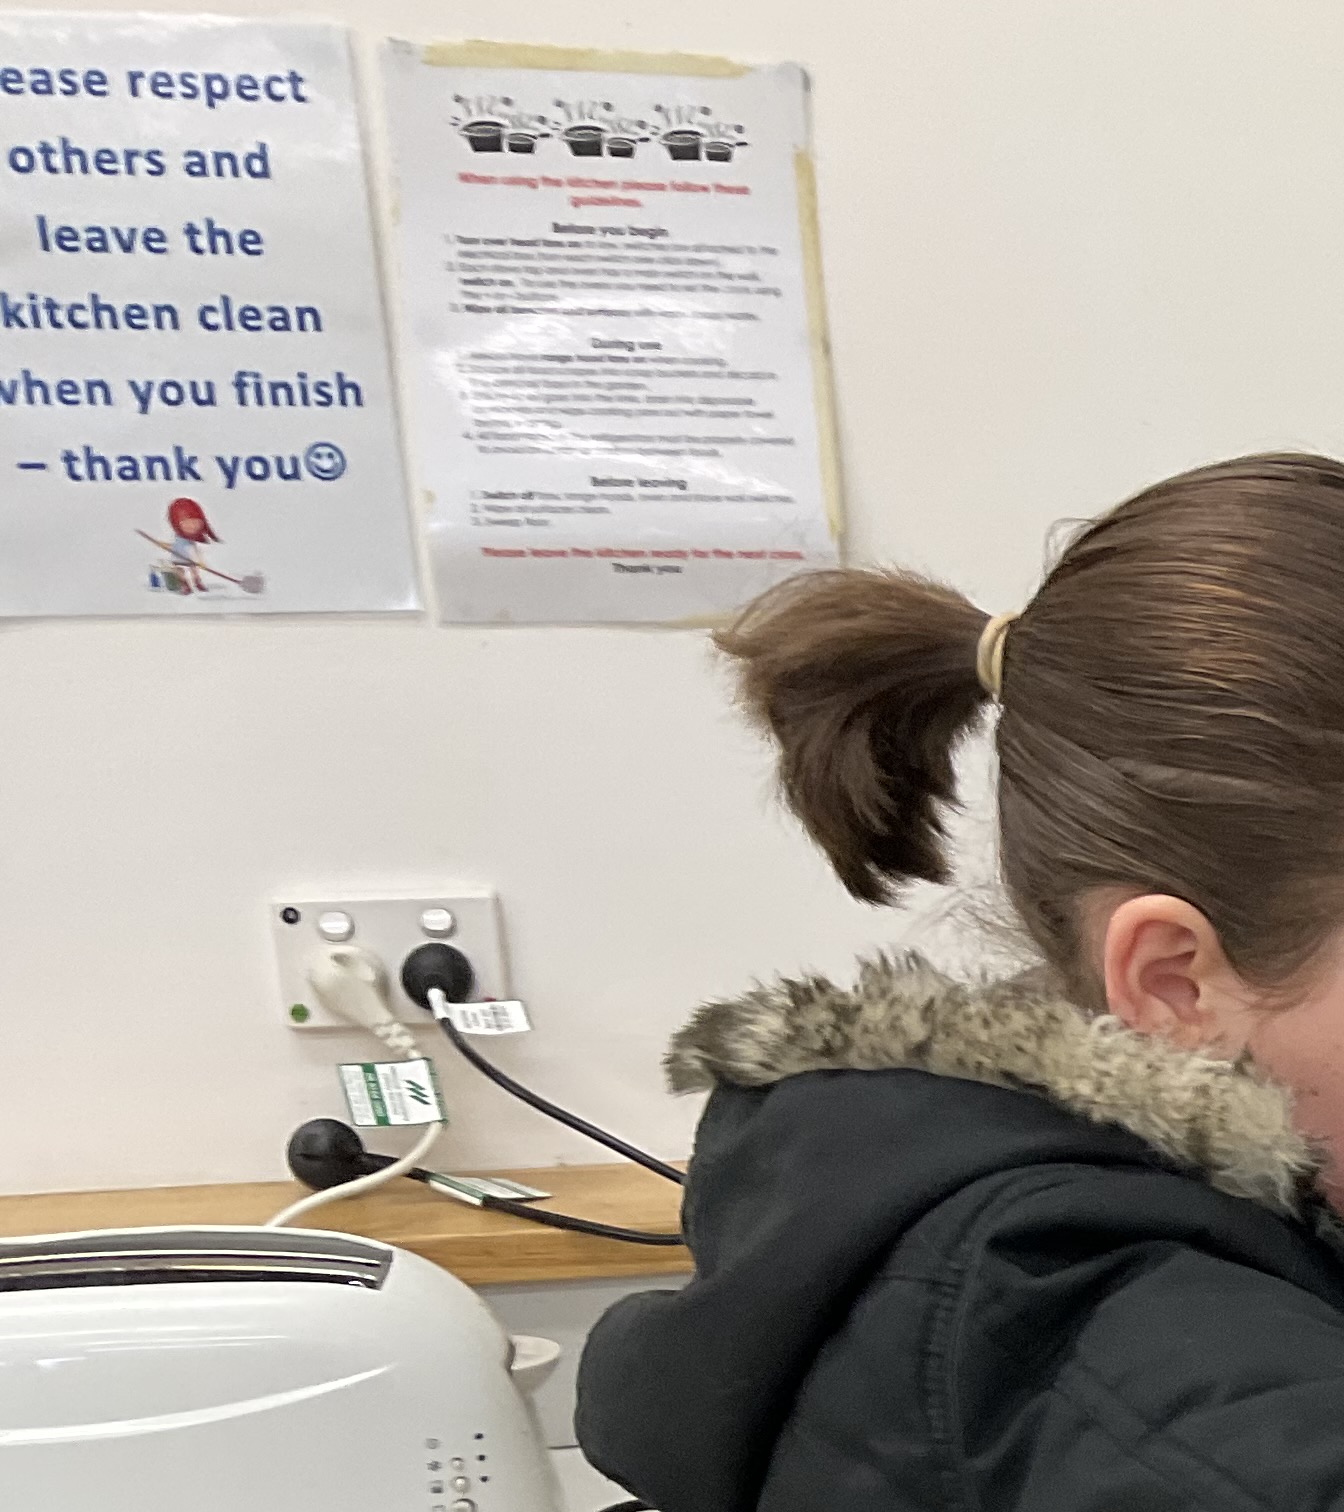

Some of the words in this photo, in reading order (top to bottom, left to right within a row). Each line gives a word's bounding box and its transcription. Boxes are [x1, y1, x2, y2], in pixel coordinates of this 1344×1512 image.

[127, 68, 309, 108] respect
[8, 138, 166, 177] others
[183, 142, 272, 180] and
[37, 215, 168, 254] leave
[183, 218, 264, 257] the
[0, 292, 180, 332] kitchen
[198, 295, 323, 333] clean
[127, 376, 217, 414] you
[233, 370, 364, 407] finish
[60, 446, 204, 483] thank
[215, 450, 304, 489] you
